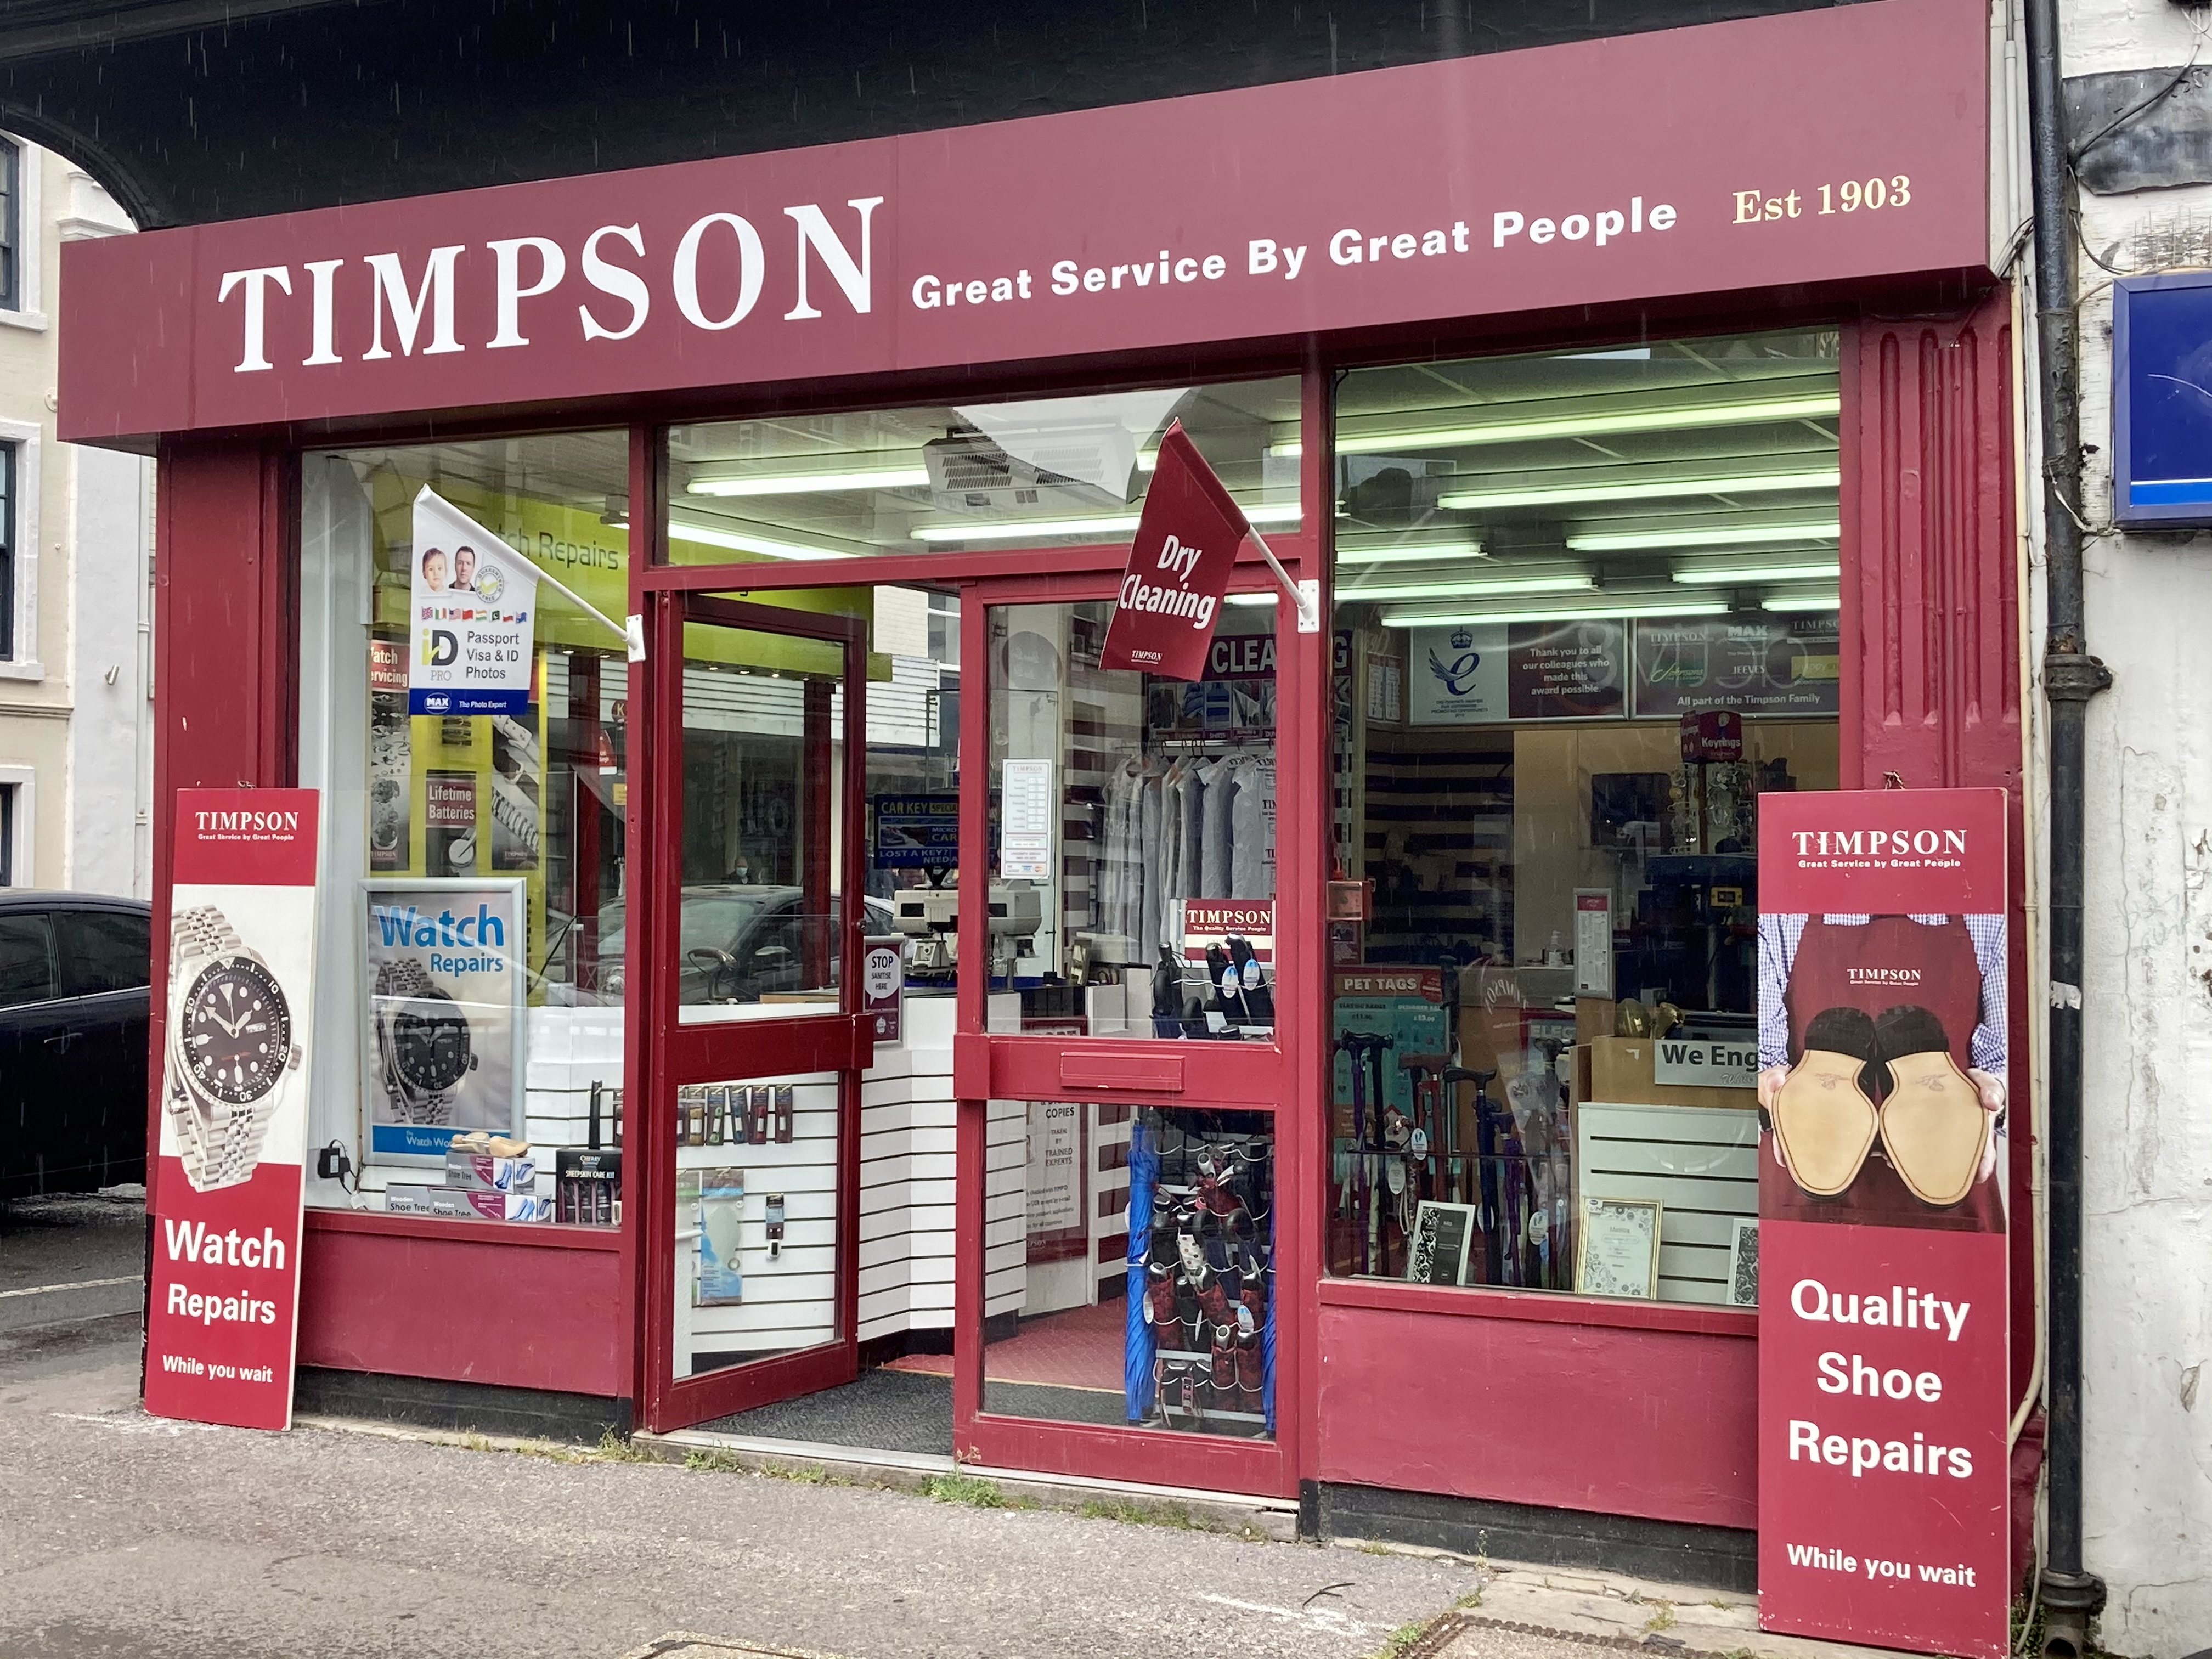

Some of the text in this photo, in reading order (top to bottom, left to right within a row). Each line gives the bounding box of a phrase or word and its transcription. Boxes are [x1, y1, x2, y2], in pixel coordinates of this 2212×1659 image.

[1733, 175, 1911, 225] Est 1903
[912, 196, 1678, 309] Great Service By Great People
[218, 196, 883, 373] TIMPSON
[539, 531, 619, 570] Repairs
[1158, 535, 1202, 582] Dry
[1119, 574, 1216, 629] Cleaning
[1728, 625, 1768, 636] MAX
[467, 631, 520, 646] Passport
[371, 647, 398, 665] atch
[467, 649, 519, 662] Visa & ID
[1132, 650, 1163, 661] TIMPSON
[1530, 648, 1558, 657] Thank
[1560, 649, 1577, 658] you
[1591, 646, 1602, 654] all
[1522, 659, 1610, 670] our colleagues who
[431, 670, 452, 681] PRO
[466, 666, 506, 679] Photos
[1544, 673, 1588, 682] made this
[1531, 685, 1601, 695] award possible.
[426, 697, 449, 707] MAX
[1677, 693, 1820, 707] All part of the Timpson Family
[1701, 737, 1741, 749] Keyrings
[428, 786, 472, 802] Lifetime
[428, 804, 475, 820] Batteries
[881, 802, 904, 815] CAR
[906, 802, 928, 815] KEY
[195, 812, 299, 831] TIMPSON
[243, 833, 251, 841] by
[272, 833, 294, 842] People
[932, 833, 957, 842] CAR
[1792, 830, 1967, 856] TIMPSON
[1798, 859, 1961, 868] Great Service by Great People
[1187, 910, 1272, 924] TIMPSON
[374, 904, 504, 948] Watch
[431, 953, 504, 977] Repairs
[872, 956, 894, 968] STOP
[1847, 968, 1921, 980] TIMPSON
[1345, 978, 1372, 990] PET
[1376, 978, 1417, 991] TAGS
[1662, 1044, 1758, 1073] We Eng
[1046, 1106, 1075, 1119] COPIES
[406, 1136, 432, 1147] Watch
[1045, 1147, 1073, 1158] TRAINED
[1045, 1156, 1073, 1167] EXPERTS
[448, 1169, 461, 1179] Shoe
[593, 1170, 606, 1179] CARE
[390, 1203, 411, 1211] Shoe
[433, 1207, 453, 1216] Shoe
[165, 1218, 285, 1270] Watch
[167, 1283, 276, 1326] Repairs
[1791, 1279, 1971, 1342] Quality
[162, 1355, 273, 1383] While you wait
[1816, 1351, 1943, 1402] Shoe
[1789, 1419, 1973, 1479] Repairs
[1786, 1543, 1976, 1588] While you wait
